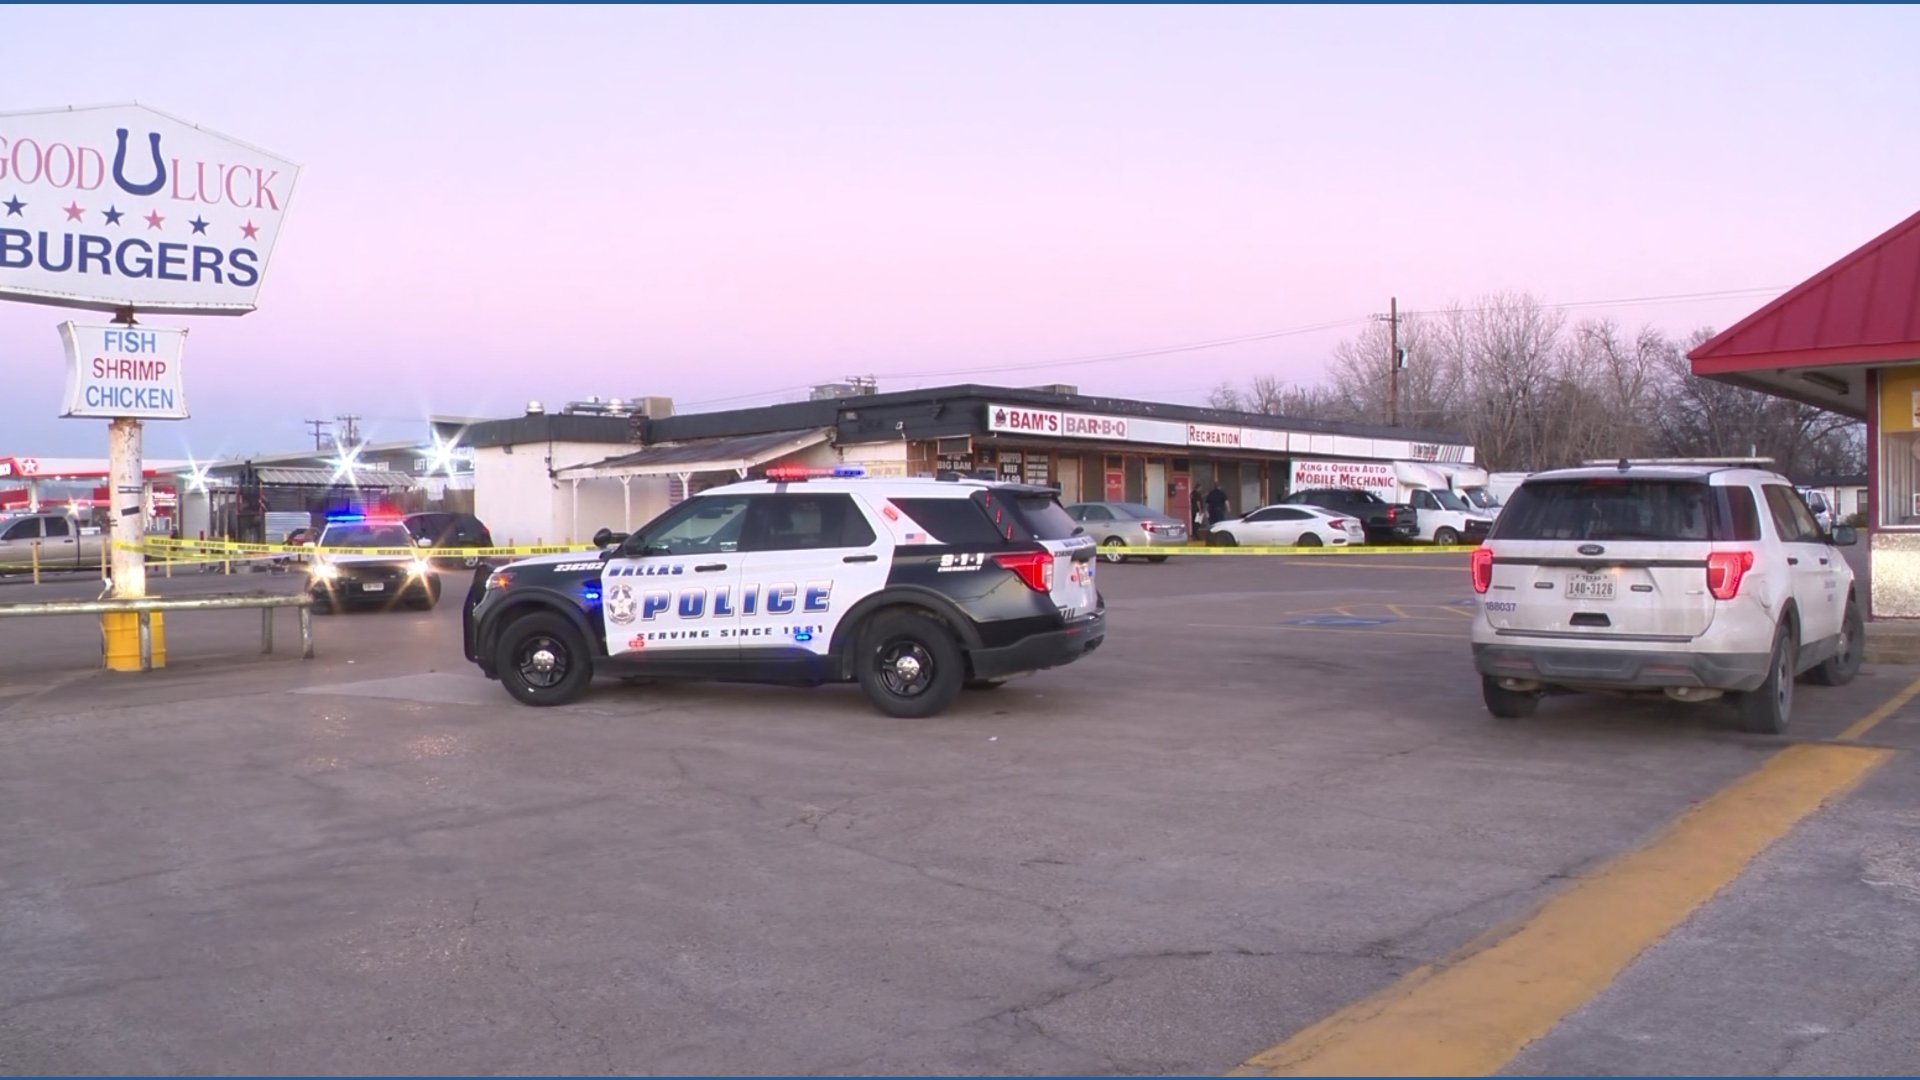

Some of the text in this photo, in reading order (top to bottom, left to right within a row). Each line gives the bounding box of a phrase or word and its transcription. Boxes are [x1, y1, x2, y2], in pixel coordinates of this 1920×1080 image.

[171, 157, 280, 211] LUCK
[0, 227, 259, 288] BURGERS
[104, 330, 156, 354] FISH
[93, 357, 167, 381] SHRIMP
[86, 385, 173, 409] CHICKEN
[1010, 410, 1058, 432] BAM'S
[1189, 425, 1239, 444] RECREATION
[937, 461, 972, 471] BIG BAM
[1300, 463, 1322, 472] KING
[1331, 464, 1360, 473] QUEEN
[1362, 465, 1387, 474] AUTO
[1295, 472, 1394, 488] MOBILE MECHANIC
[553, 561, 605, 572] 238202
[608, 563, 685, 577] DALLAS
[640, 579, 834, 622] POLICE
[1485, 601, 1517, 612] 188037
[636, 624, 823, 641] SERVING SINCE 1881
